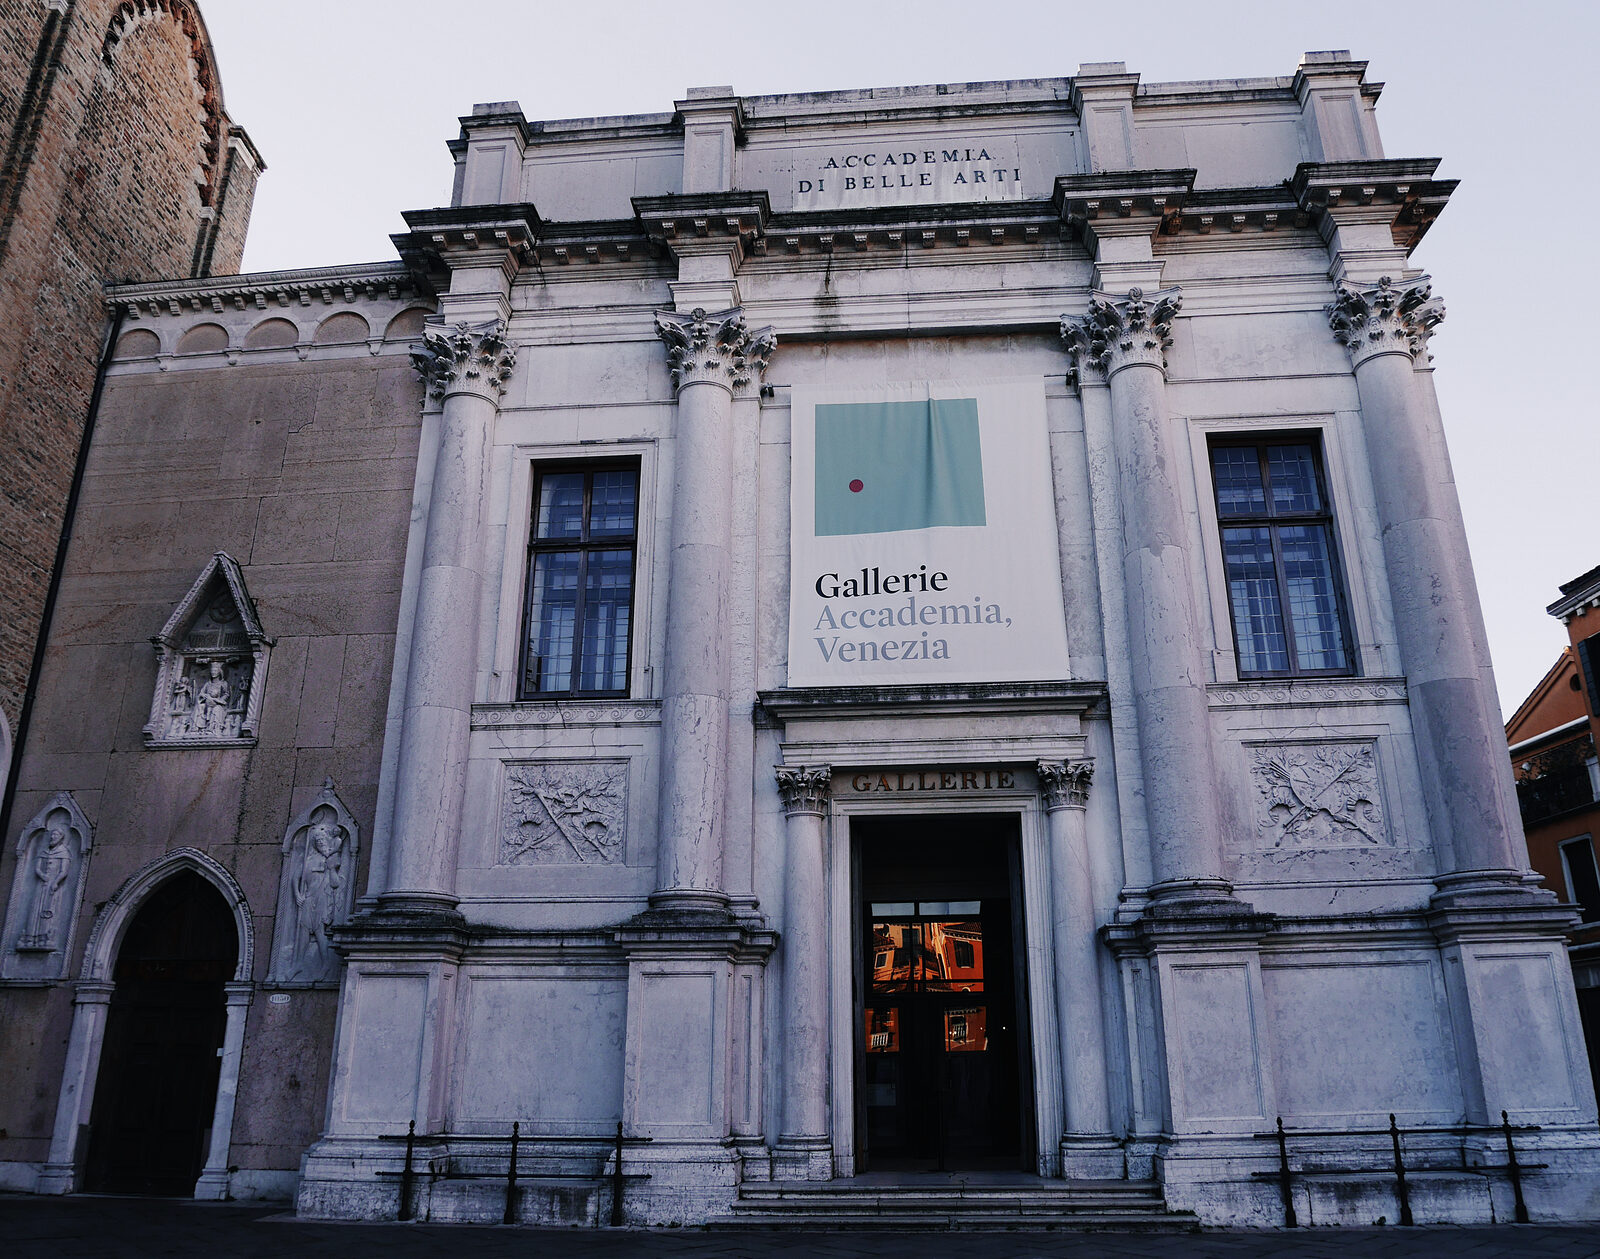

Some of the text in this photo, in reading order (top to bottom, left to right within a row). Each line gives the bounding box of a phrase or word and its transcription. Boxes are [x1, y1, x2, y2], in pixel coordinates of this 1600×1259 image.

[826, 148, 991, 169] ACCADEMIA
[799, 168, 1021, 193] DI BELLE ARTI
[815, 564, 948, 598] Gallerie
[813, 595, 1012, 631] Accademia,
[813, 631, 951, 663] Venezia
[852, 770, 1015, 792] GALLERIE
